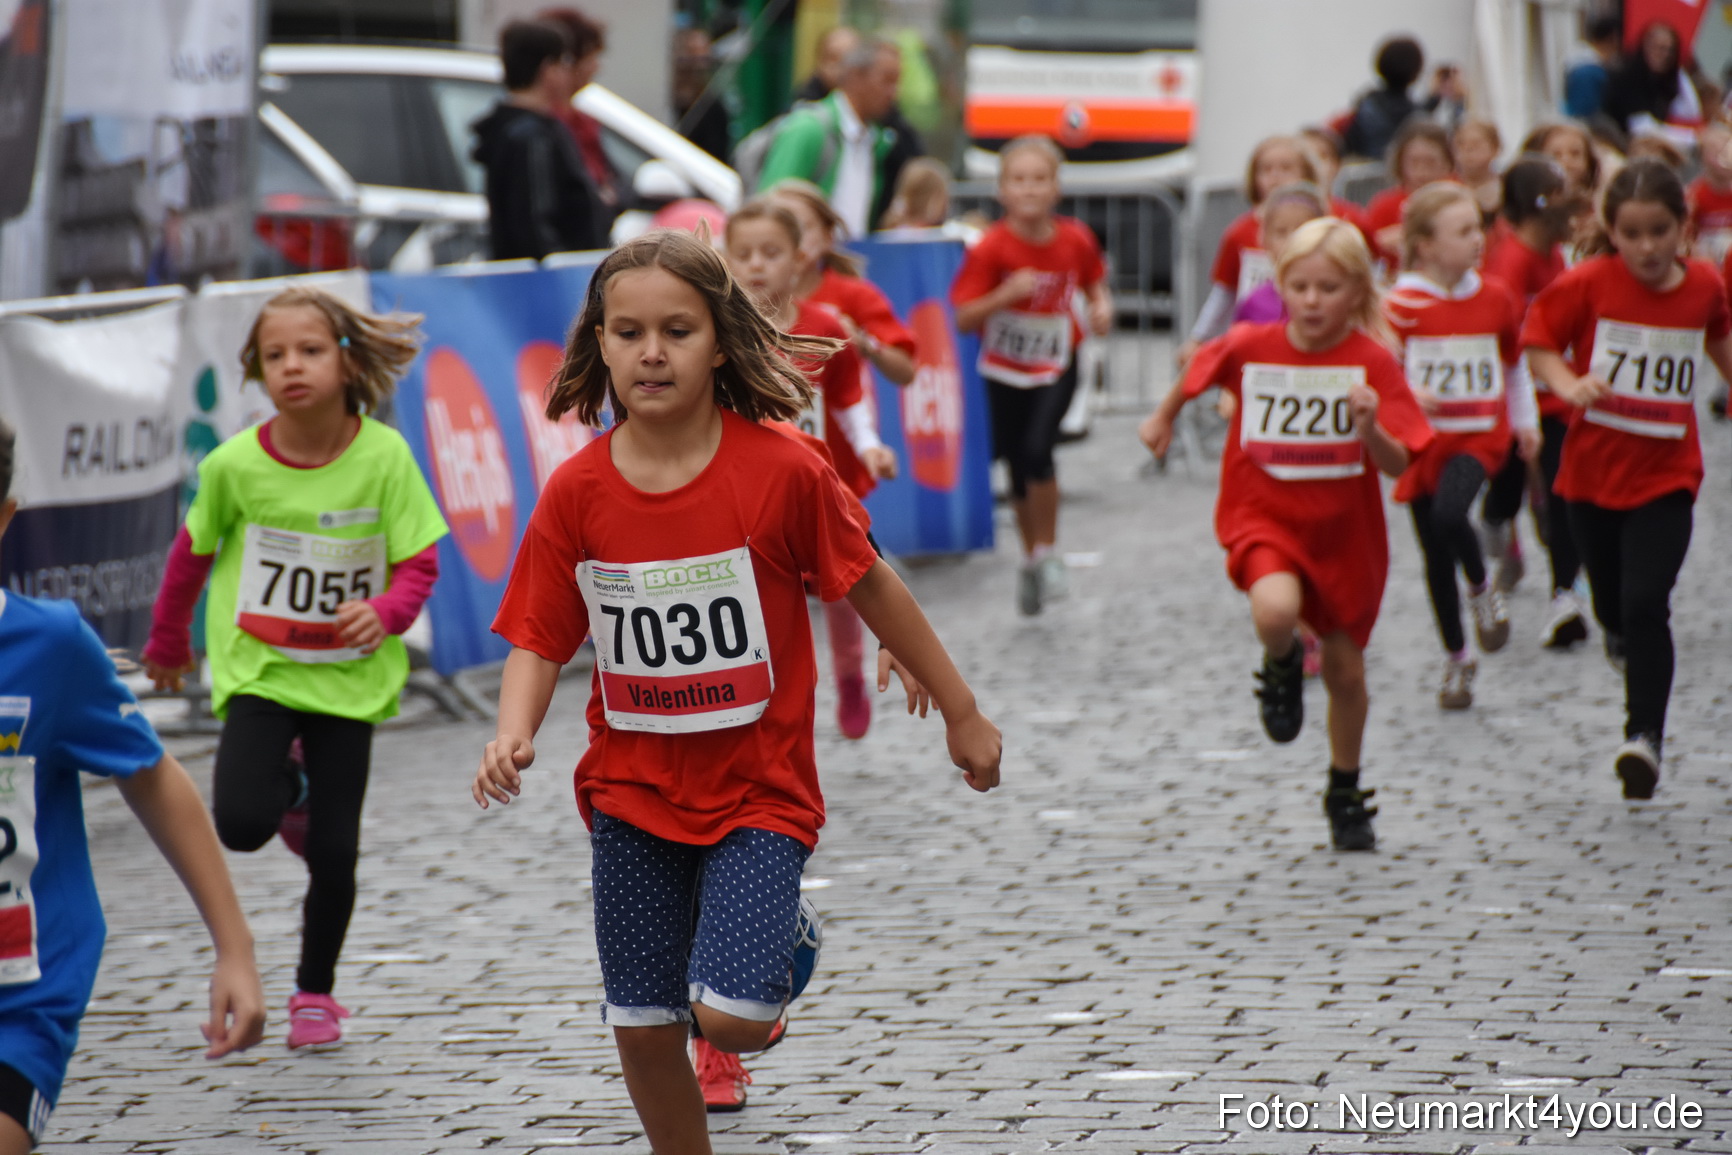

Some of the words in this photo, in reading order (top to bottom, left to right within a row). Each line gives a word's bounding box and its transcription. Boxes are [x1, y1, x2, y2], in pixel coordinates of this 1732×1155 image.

[1417, 358, 1493, 395] 7219
[1605, 349, 1695, 396] 7190
[1254, 393, 1354, 437] 7220
[259, 558, 373, 616] 7055
[593, 580, 636, 594] NeuerMarkt
[644, 558, 736, 589] BOCK
[646, 589, 674, 598] inspired
[675, 586, 684, 595] by
[685, 584, 706, 593] smart
[707, 579, 740, 591] concepts
[600, 596, 749, 668] 7030
[754, 648, 763, 661] K
[626, 682, 737, 709] Valentina
